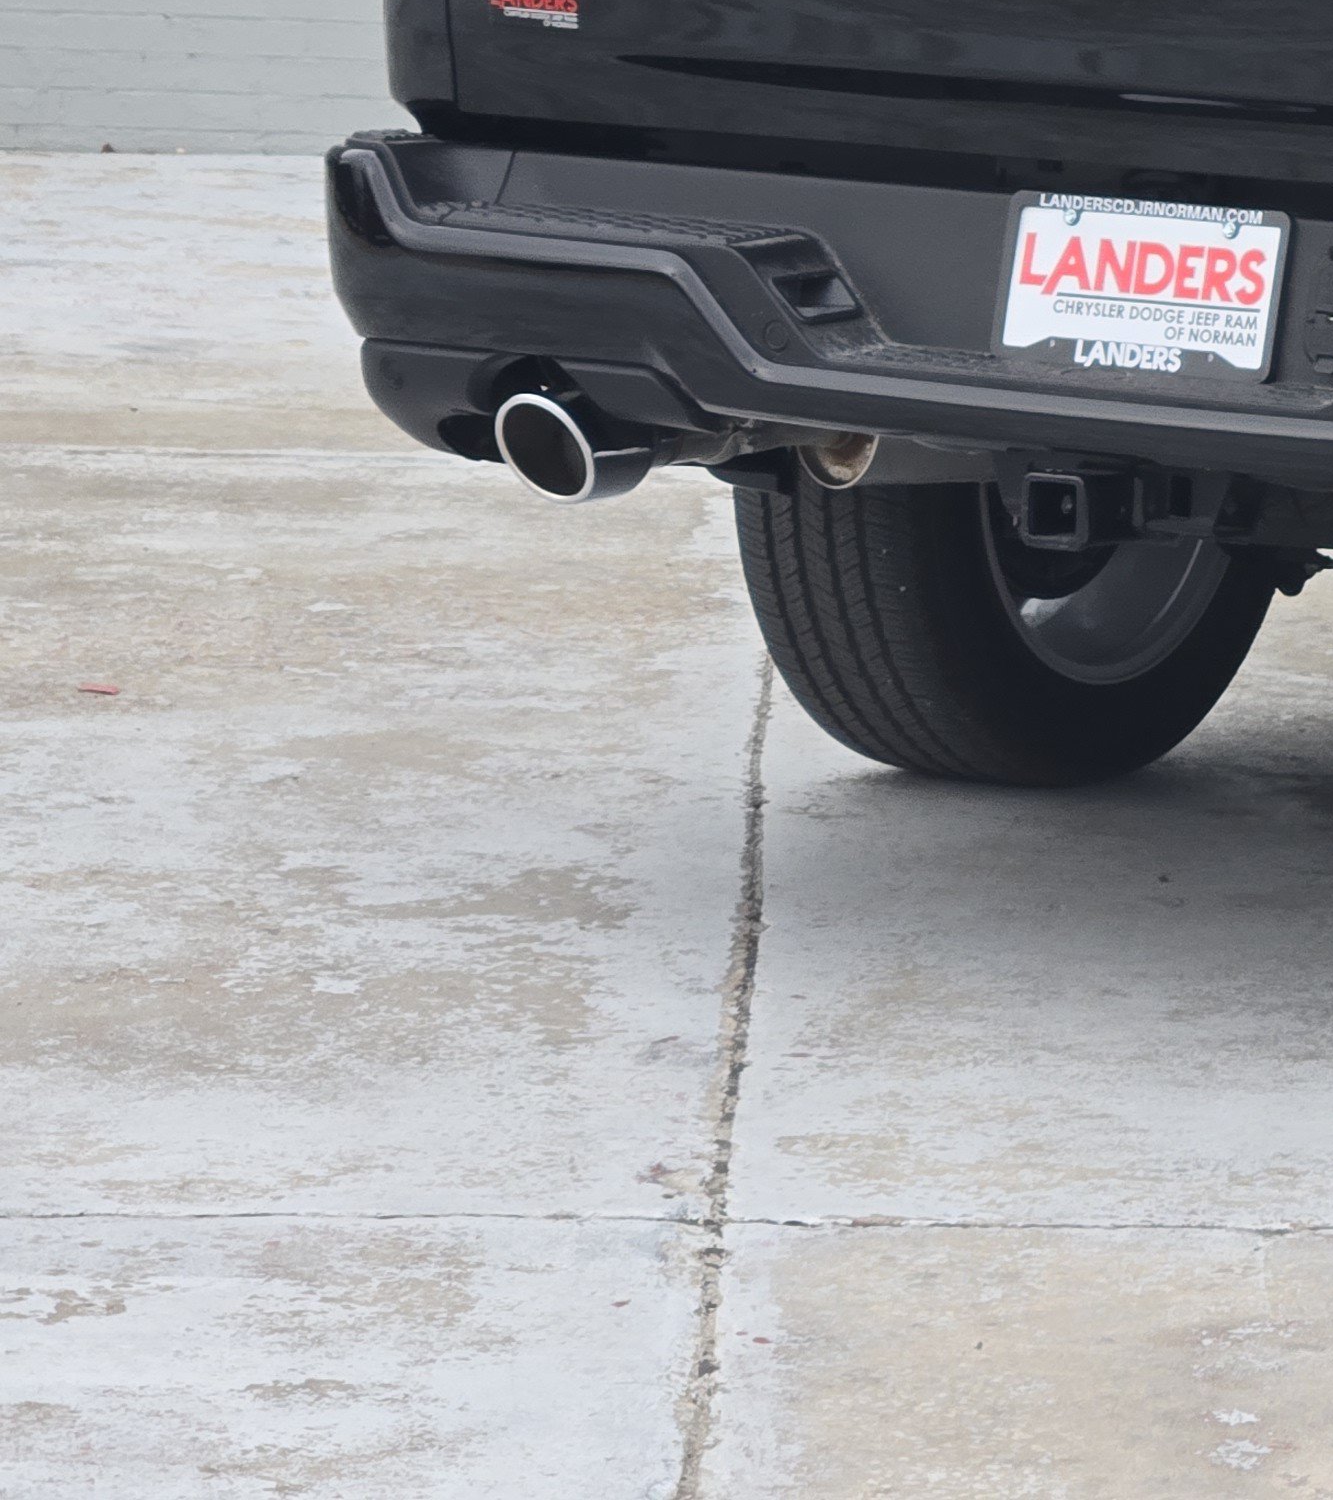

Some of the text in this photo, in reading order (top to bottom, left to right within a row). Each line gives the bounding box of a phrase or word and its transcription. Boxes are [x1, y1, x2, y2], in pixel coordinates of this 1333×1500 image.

[1039, 192, 1263, 225] LANDERSCDJRNORMAN.COM
[1018, 232, 1267, 306] LANDERS
[1052, 300, 1257, 330] CHRYSLER DODGE JEEP RAM
[1164, 326, 1257, 347] OF NORMAN
[1073, 339, 1182, 373] LANDERS
